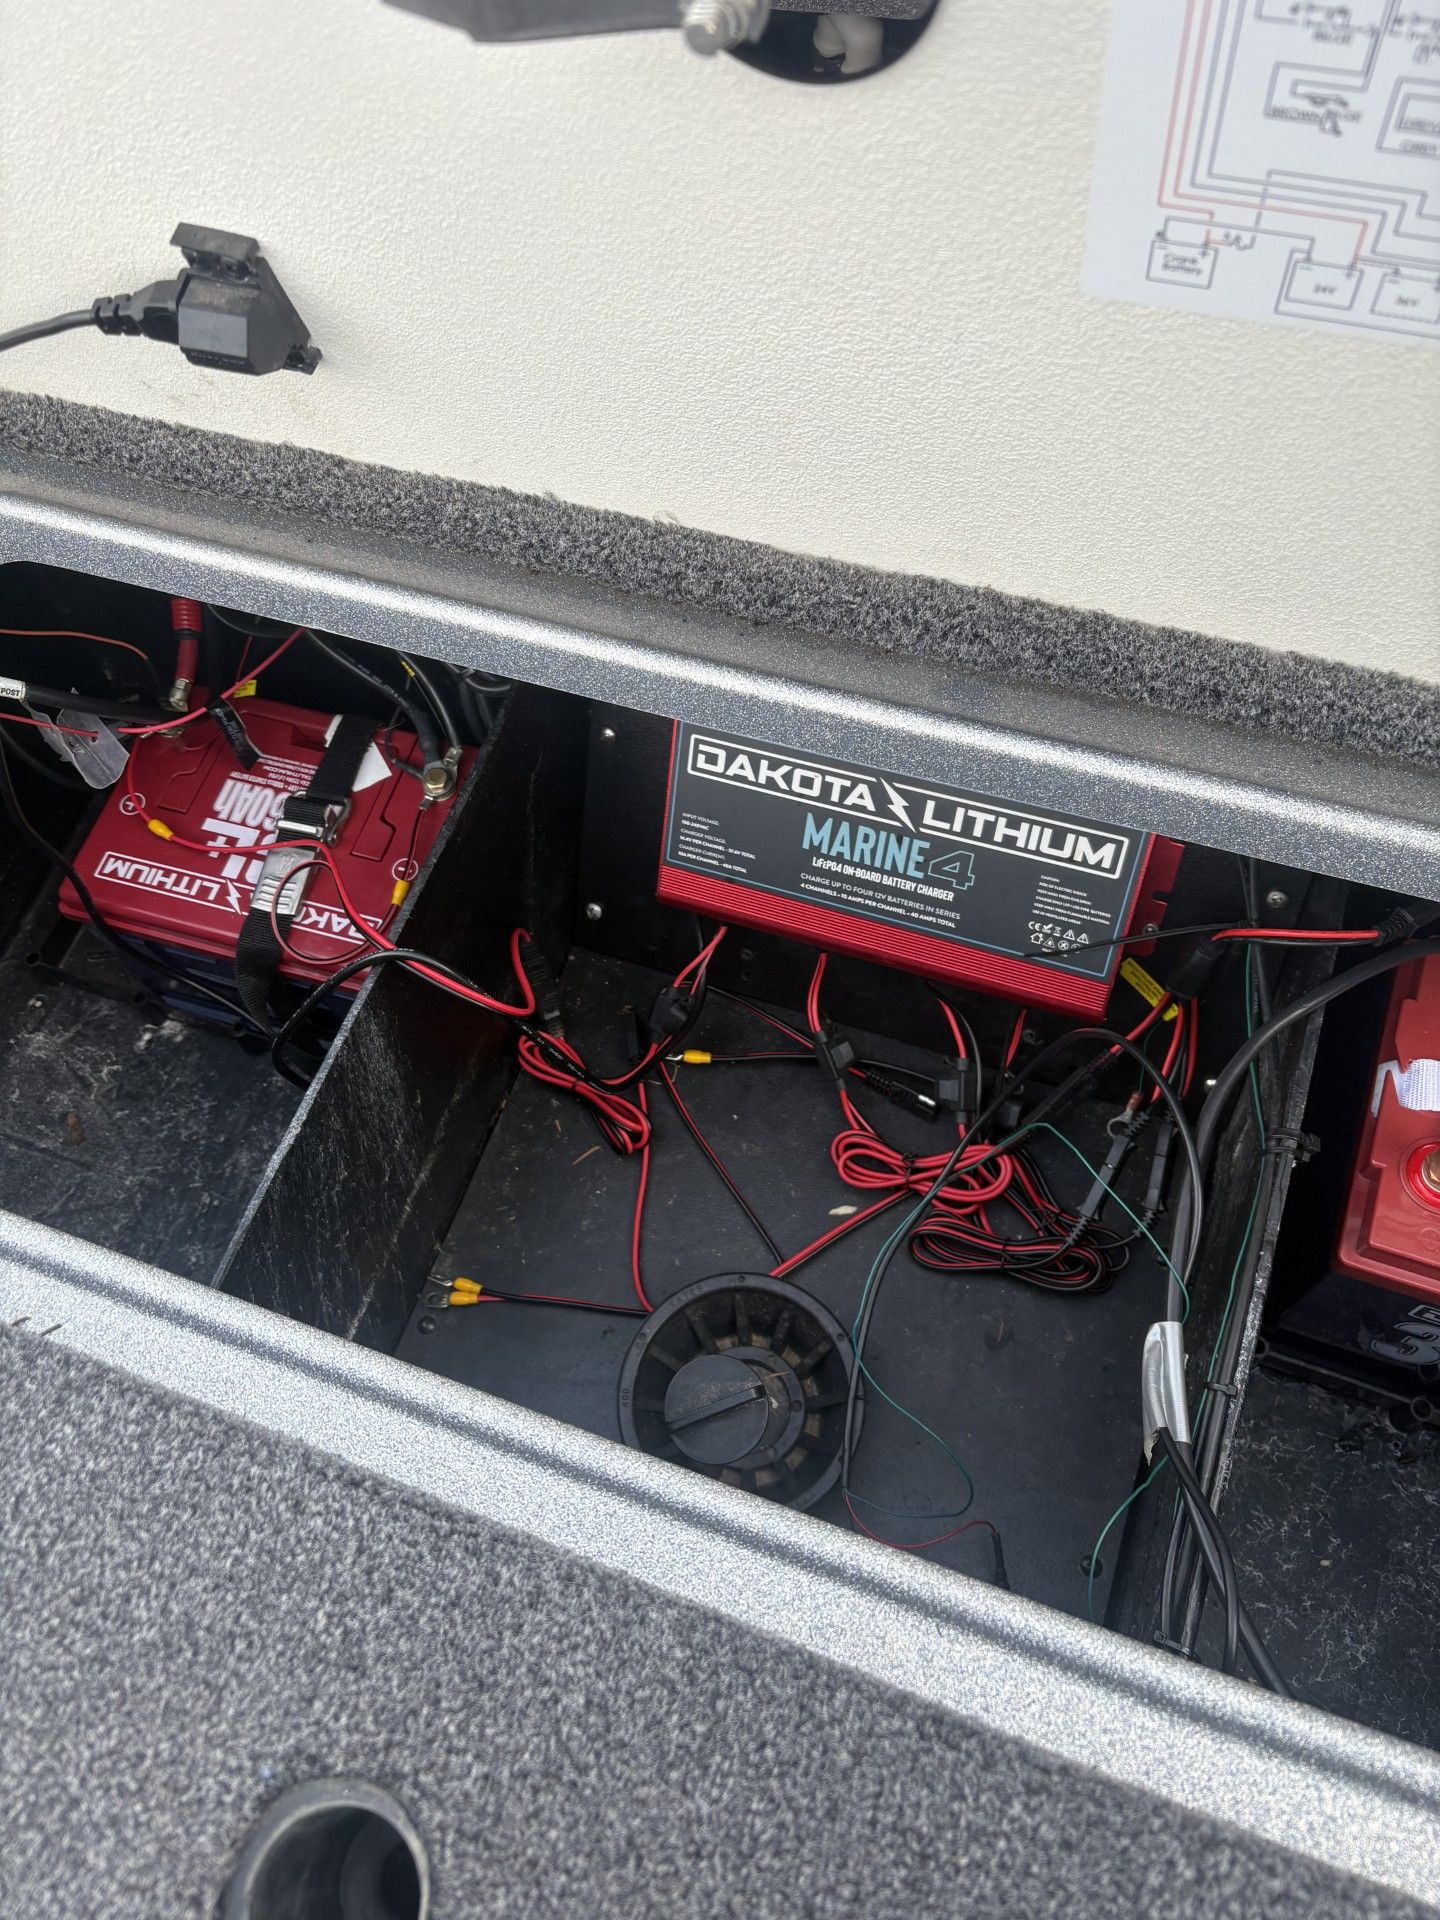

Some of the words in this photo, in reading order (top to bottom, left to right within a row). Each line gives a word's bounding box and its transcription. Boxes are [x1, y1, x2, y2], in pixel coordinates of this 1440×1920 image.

[1162, 262, 1202, 276] Battery
[1, 687, 20, 697] POST
[696, 742, 874, 812] DAKOTA
[922, 799, 1115, 868] LITHIUM
[801, 811, 929, 879] MARINE
[928, 849, 974, 889] 4
[104, 857, 220, 902] LITHIUM
[801, 873, 829, 885] CHARGE
[853, 886, 873, 896] FOUR
[874, 892, 887, 900] 12V
[887, 895, 925, 910] BATTERIES
[935, 908, 960, 919] SERIES
[843, 864, 880, 883] ON-BOARD
[882, 874, 915, 892] BATTERY
[916, 883, 954, 902] CHARGER
[806, 884, 836, 896] CHANNELS
[849, 895, 864, 904] AMPS
[877, 903, 906, 915] CHANNEL
[920, 914, 937, 923] AMPS
[937, 918, 956, 928] TOTAL
